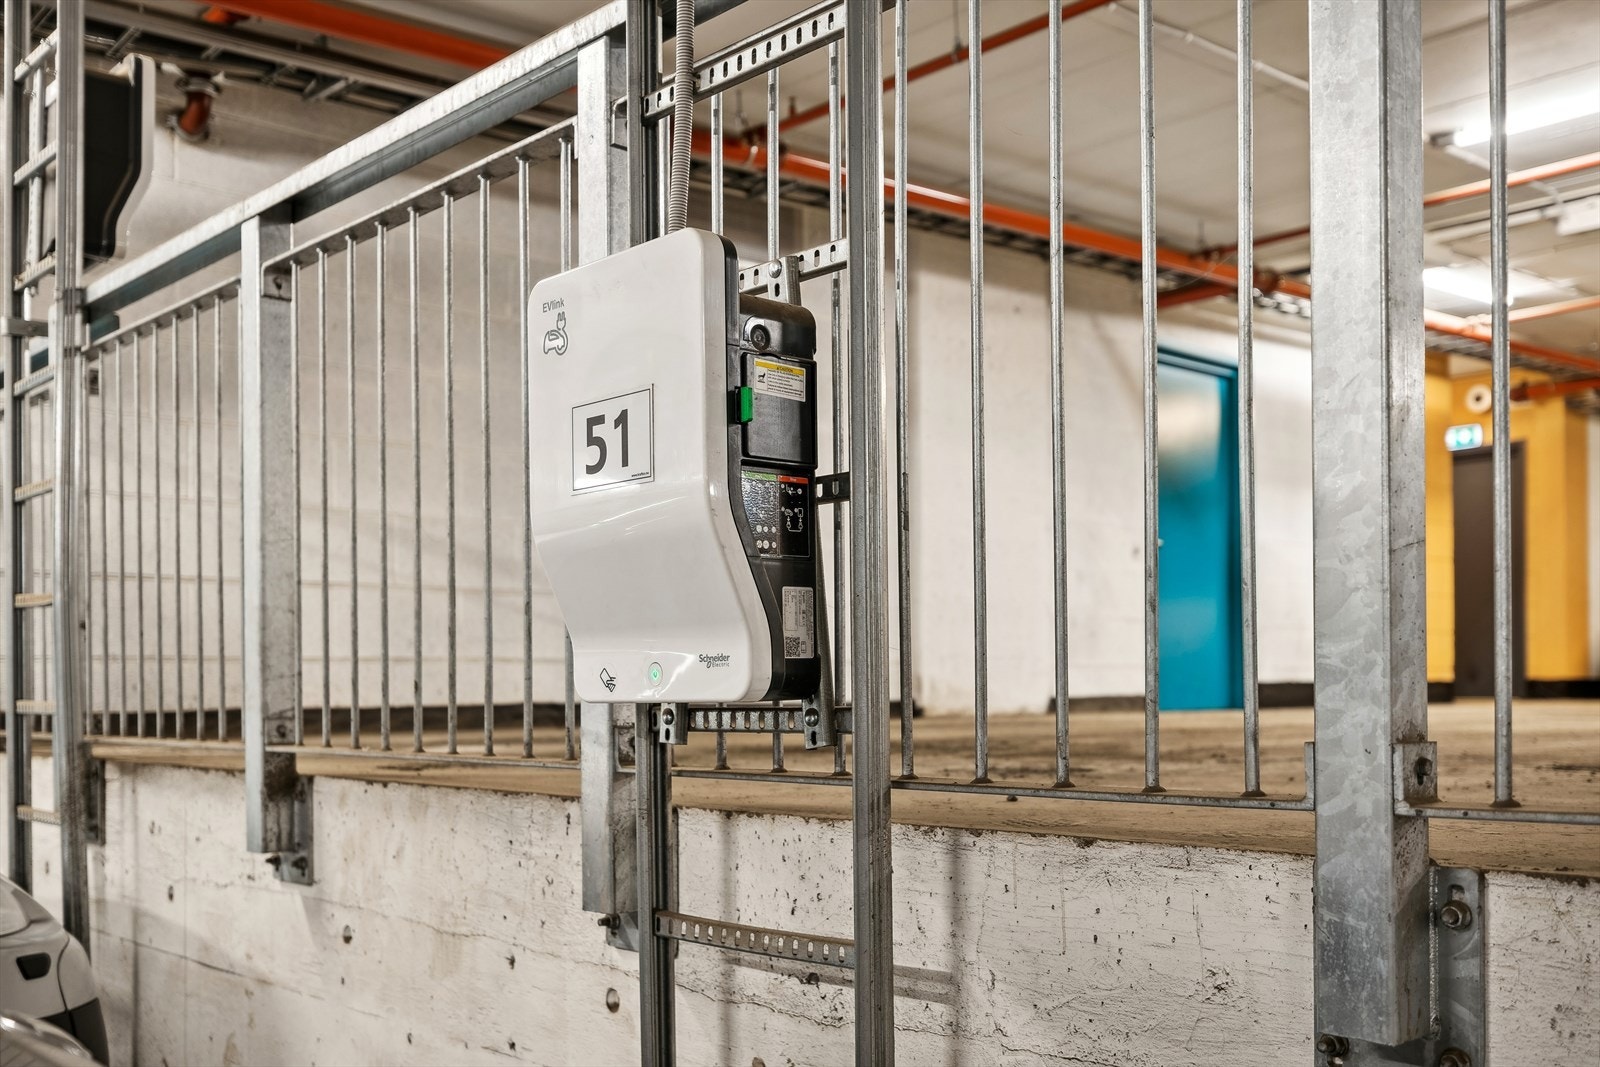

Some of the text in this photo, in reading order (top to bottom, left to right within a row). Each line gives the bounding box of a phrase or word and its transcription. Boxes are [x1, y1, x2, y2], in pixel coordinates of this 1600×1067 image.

[542, 298, 565, 313] EVlink
[585, 408, 629, 475] 51
[698, 653, 731, 664] Schneider
